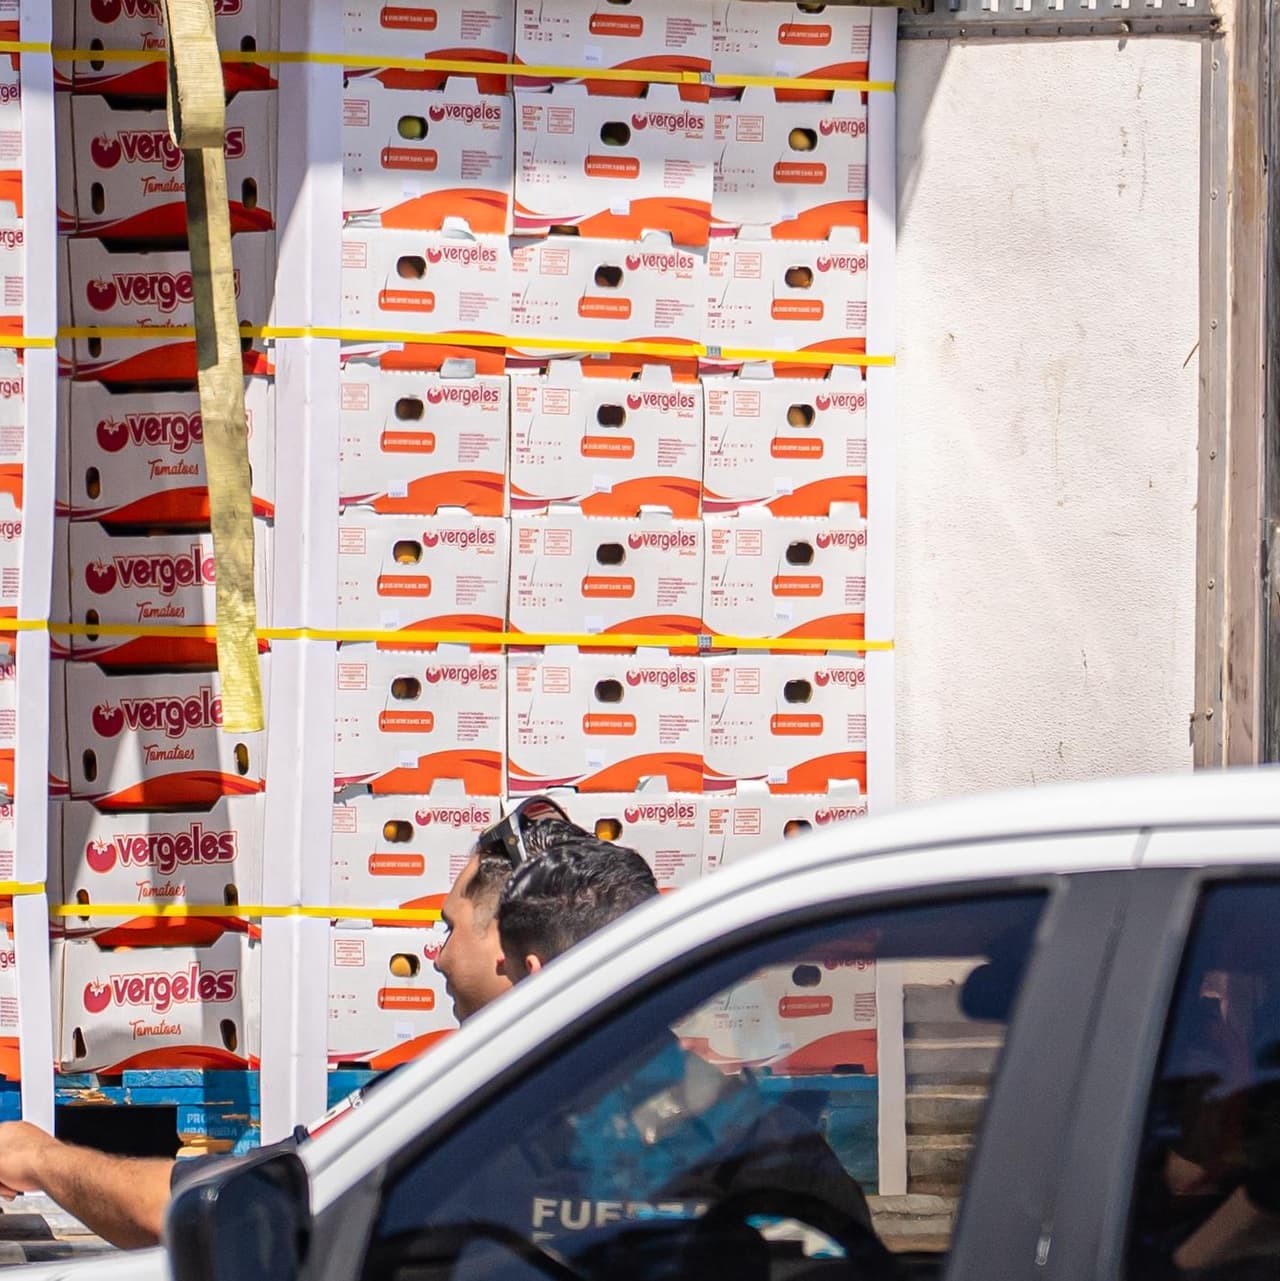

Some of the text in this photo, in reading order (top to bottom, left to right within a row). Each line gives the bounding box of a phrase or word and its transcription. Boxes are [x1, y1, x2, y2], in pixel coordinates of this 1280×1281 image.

[443, 102, 501, 123] vergeles
[646, 111, 704, 131] vergeles
[441, 245, 497, 264] vergeles
[640, 251, 694, 271] vergeles
[441, 385, 499, 404] vergeles
[642, 390, 695, 410] vergeles
[148, 458, 199, 480] Tomatoes
[439, 528, 495, 548] vergeles
[642, 530, 697, 550] vergeles
[136, 602, 185, 622] Tomatoes
[441, 664, 498, 684] vergeles
[641, 667, 696, 686] vergeles
[143, 743, 195, 764] Tomatoes
[432, 806, 490, 826] vergeles
[639, 802, 695, 823] vergeles
[114, 823, 238, 875] vergeles
[136, 880, 186, 901] Tomatoes
[110, 961, 237, 1014] vergeles
[129, 1020, 182, 1040] Tomatoes
